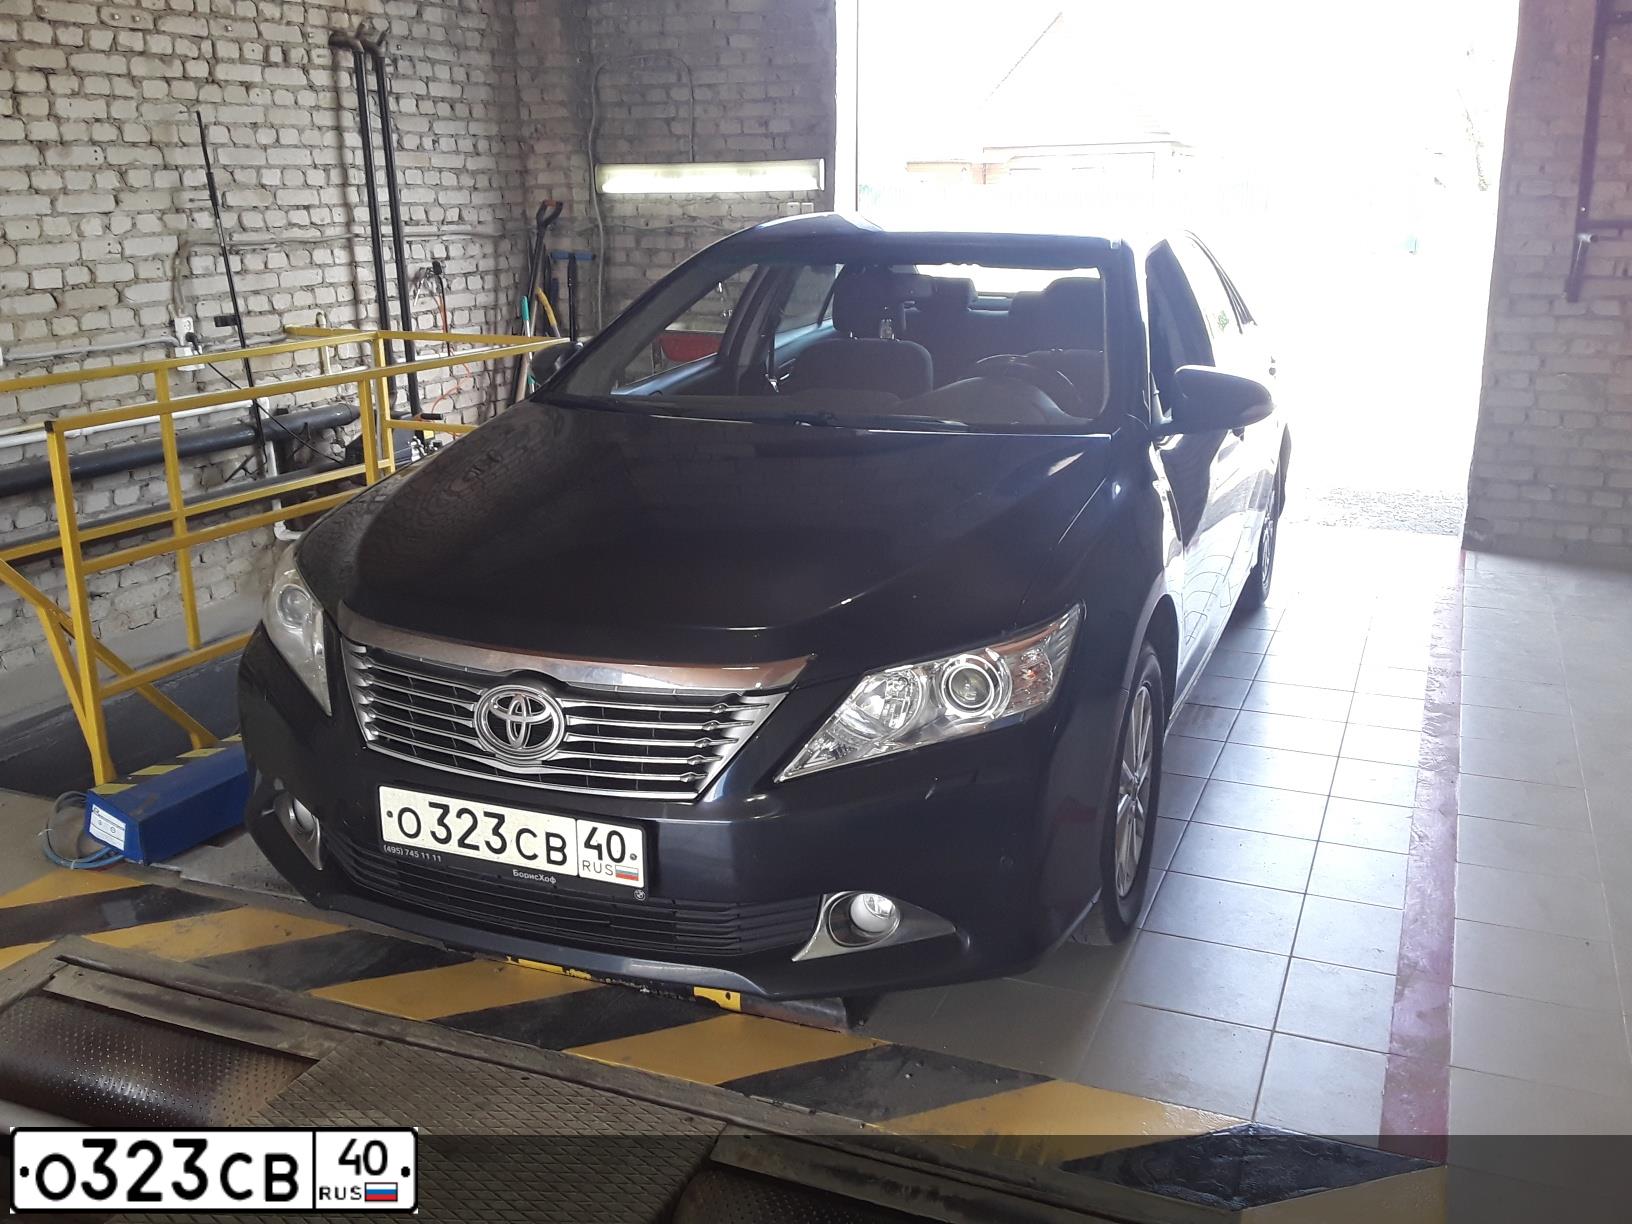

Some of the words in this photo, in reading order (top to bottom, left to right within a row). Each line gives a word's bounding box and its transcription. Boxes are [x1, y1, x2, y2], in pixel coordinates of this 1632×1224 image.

[383, 844, 403, 855] (495)
[405, 848, 420, 858] 745
[421, 852, 430, 860] 11
[432, 854, 441, 862] 11
[584, 826, 626, 864] 40
[512, 869, 557, 884] БорисХоф
[582, 860, 614, 876] RUS
